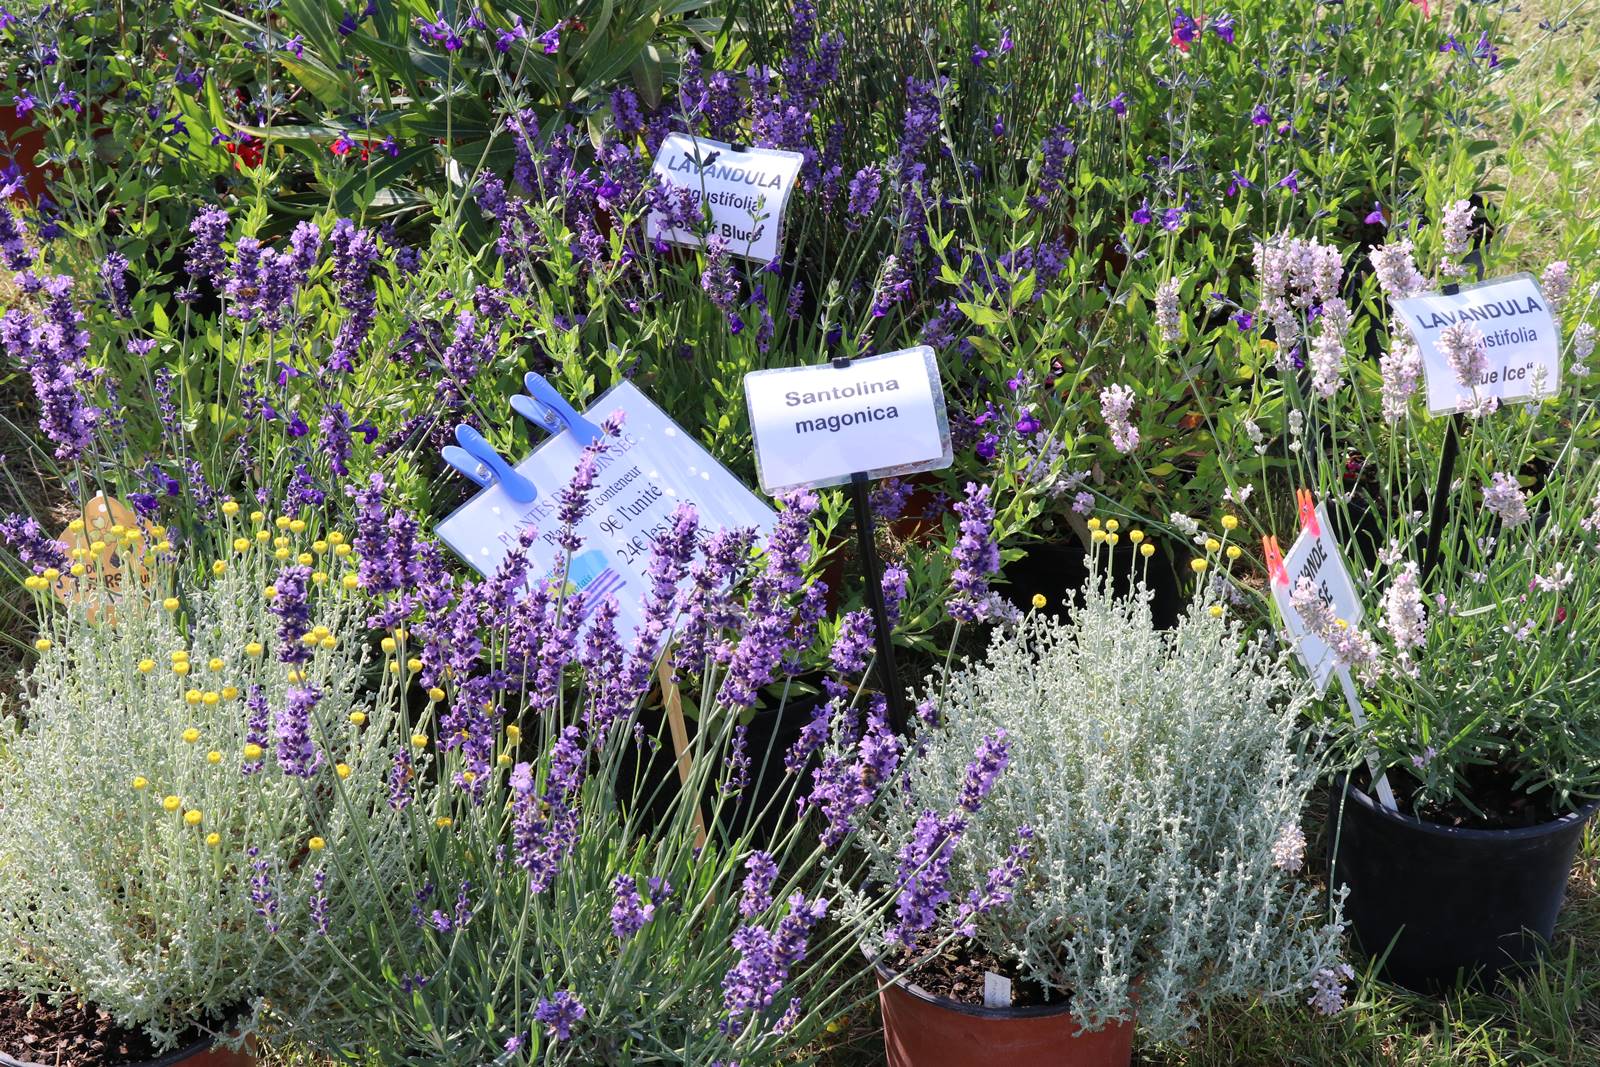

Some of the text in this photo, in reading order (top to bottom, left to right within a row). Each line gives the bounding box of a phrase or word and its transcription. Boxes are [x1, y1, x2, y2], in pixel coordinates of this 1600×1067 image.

[668, 155, 782, 190] LAVANDULA
[674, 186, 761, 212] agustifolia
[1416, 296, 1543, 330] LAVANDULA
[785, 378, 900, 407] Santolina
[795, 405, 899, 434] magonica
[611, 432, 638, 457] SEC
[583, 503, 597, 517] en
[595, 465, 642, 506] conteneur
[599, 514, 624, 537] 9€
[617, 482, 663, 522] l'unité
[616, 535, 648, 565] 24€
[641, 522, 668, 543] les
